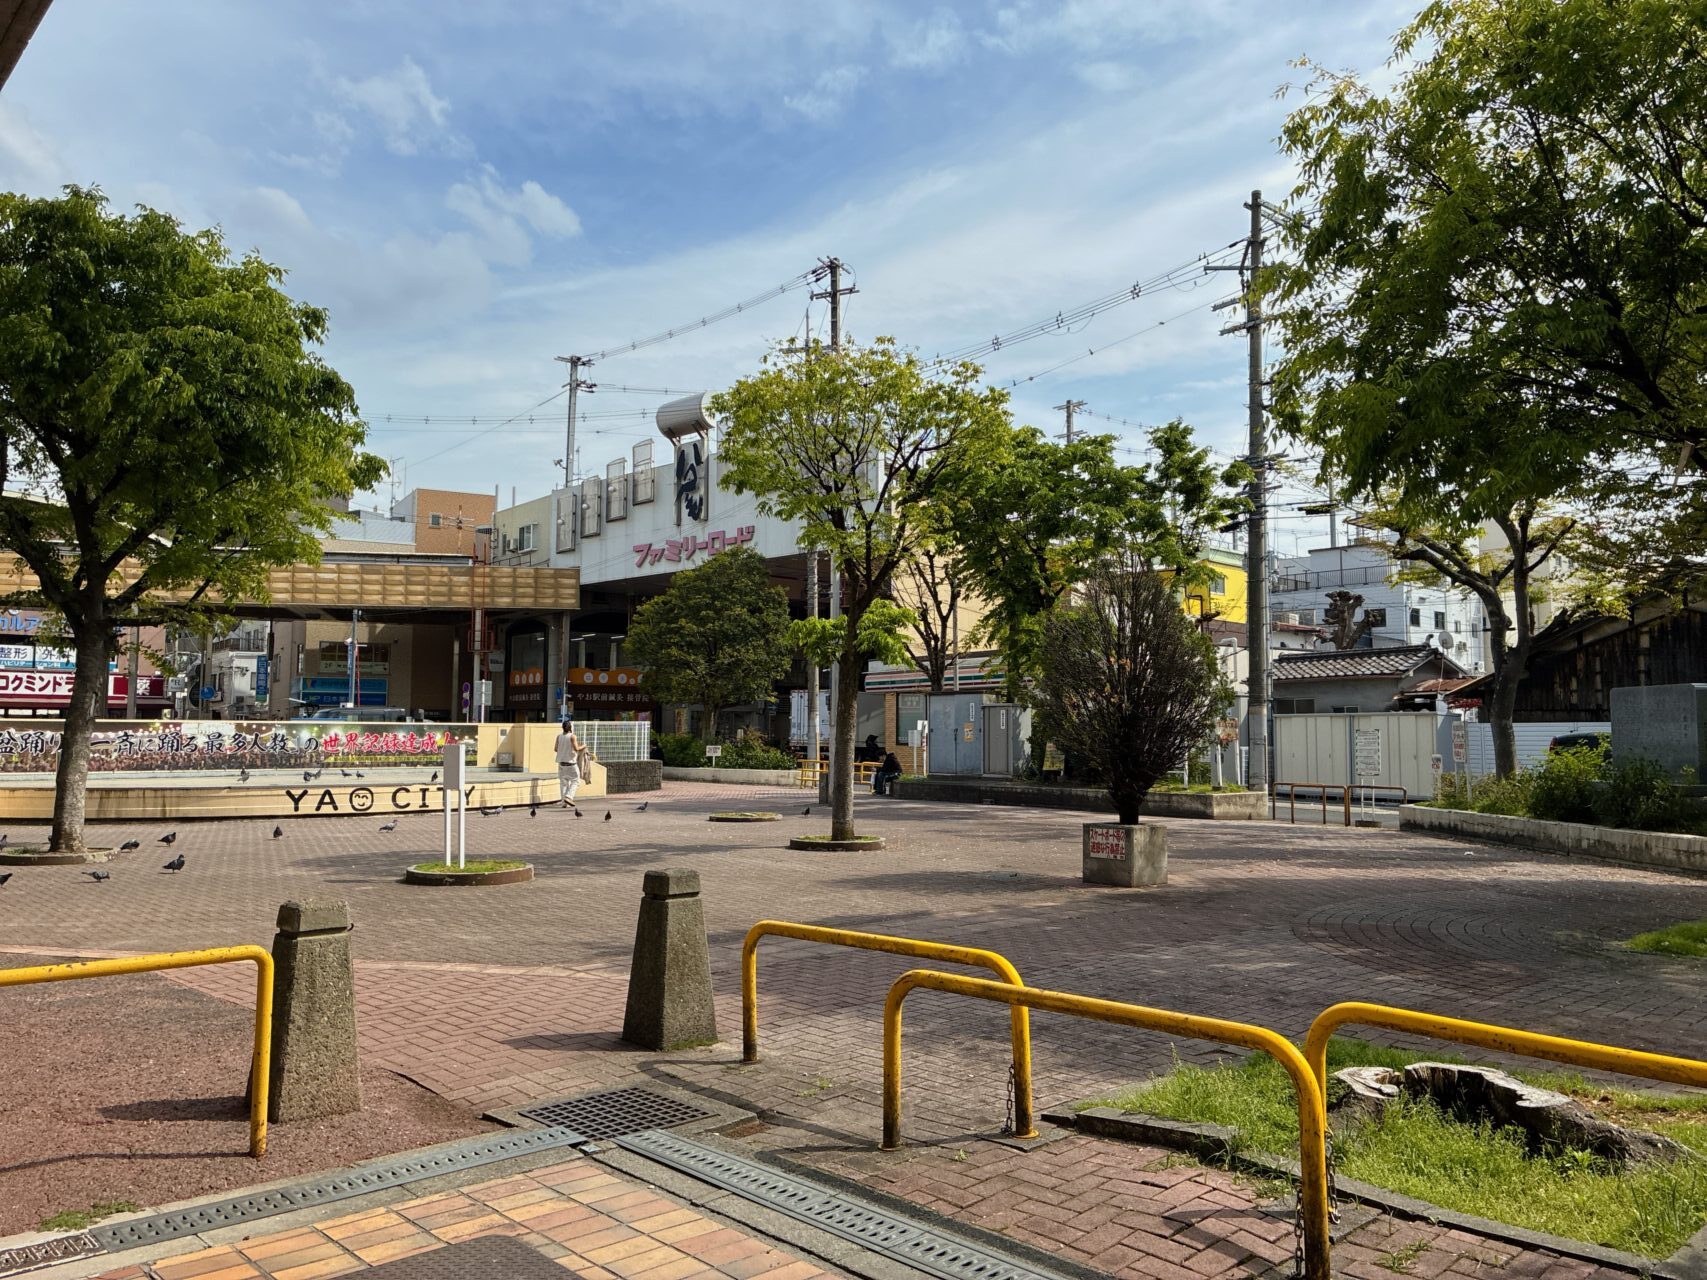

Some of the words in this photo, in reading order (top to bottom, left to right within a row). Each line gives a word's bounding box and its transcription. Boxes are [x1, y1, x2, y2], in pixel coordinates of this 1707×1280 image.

[633, 525, 755, 568] ファミリーロード
